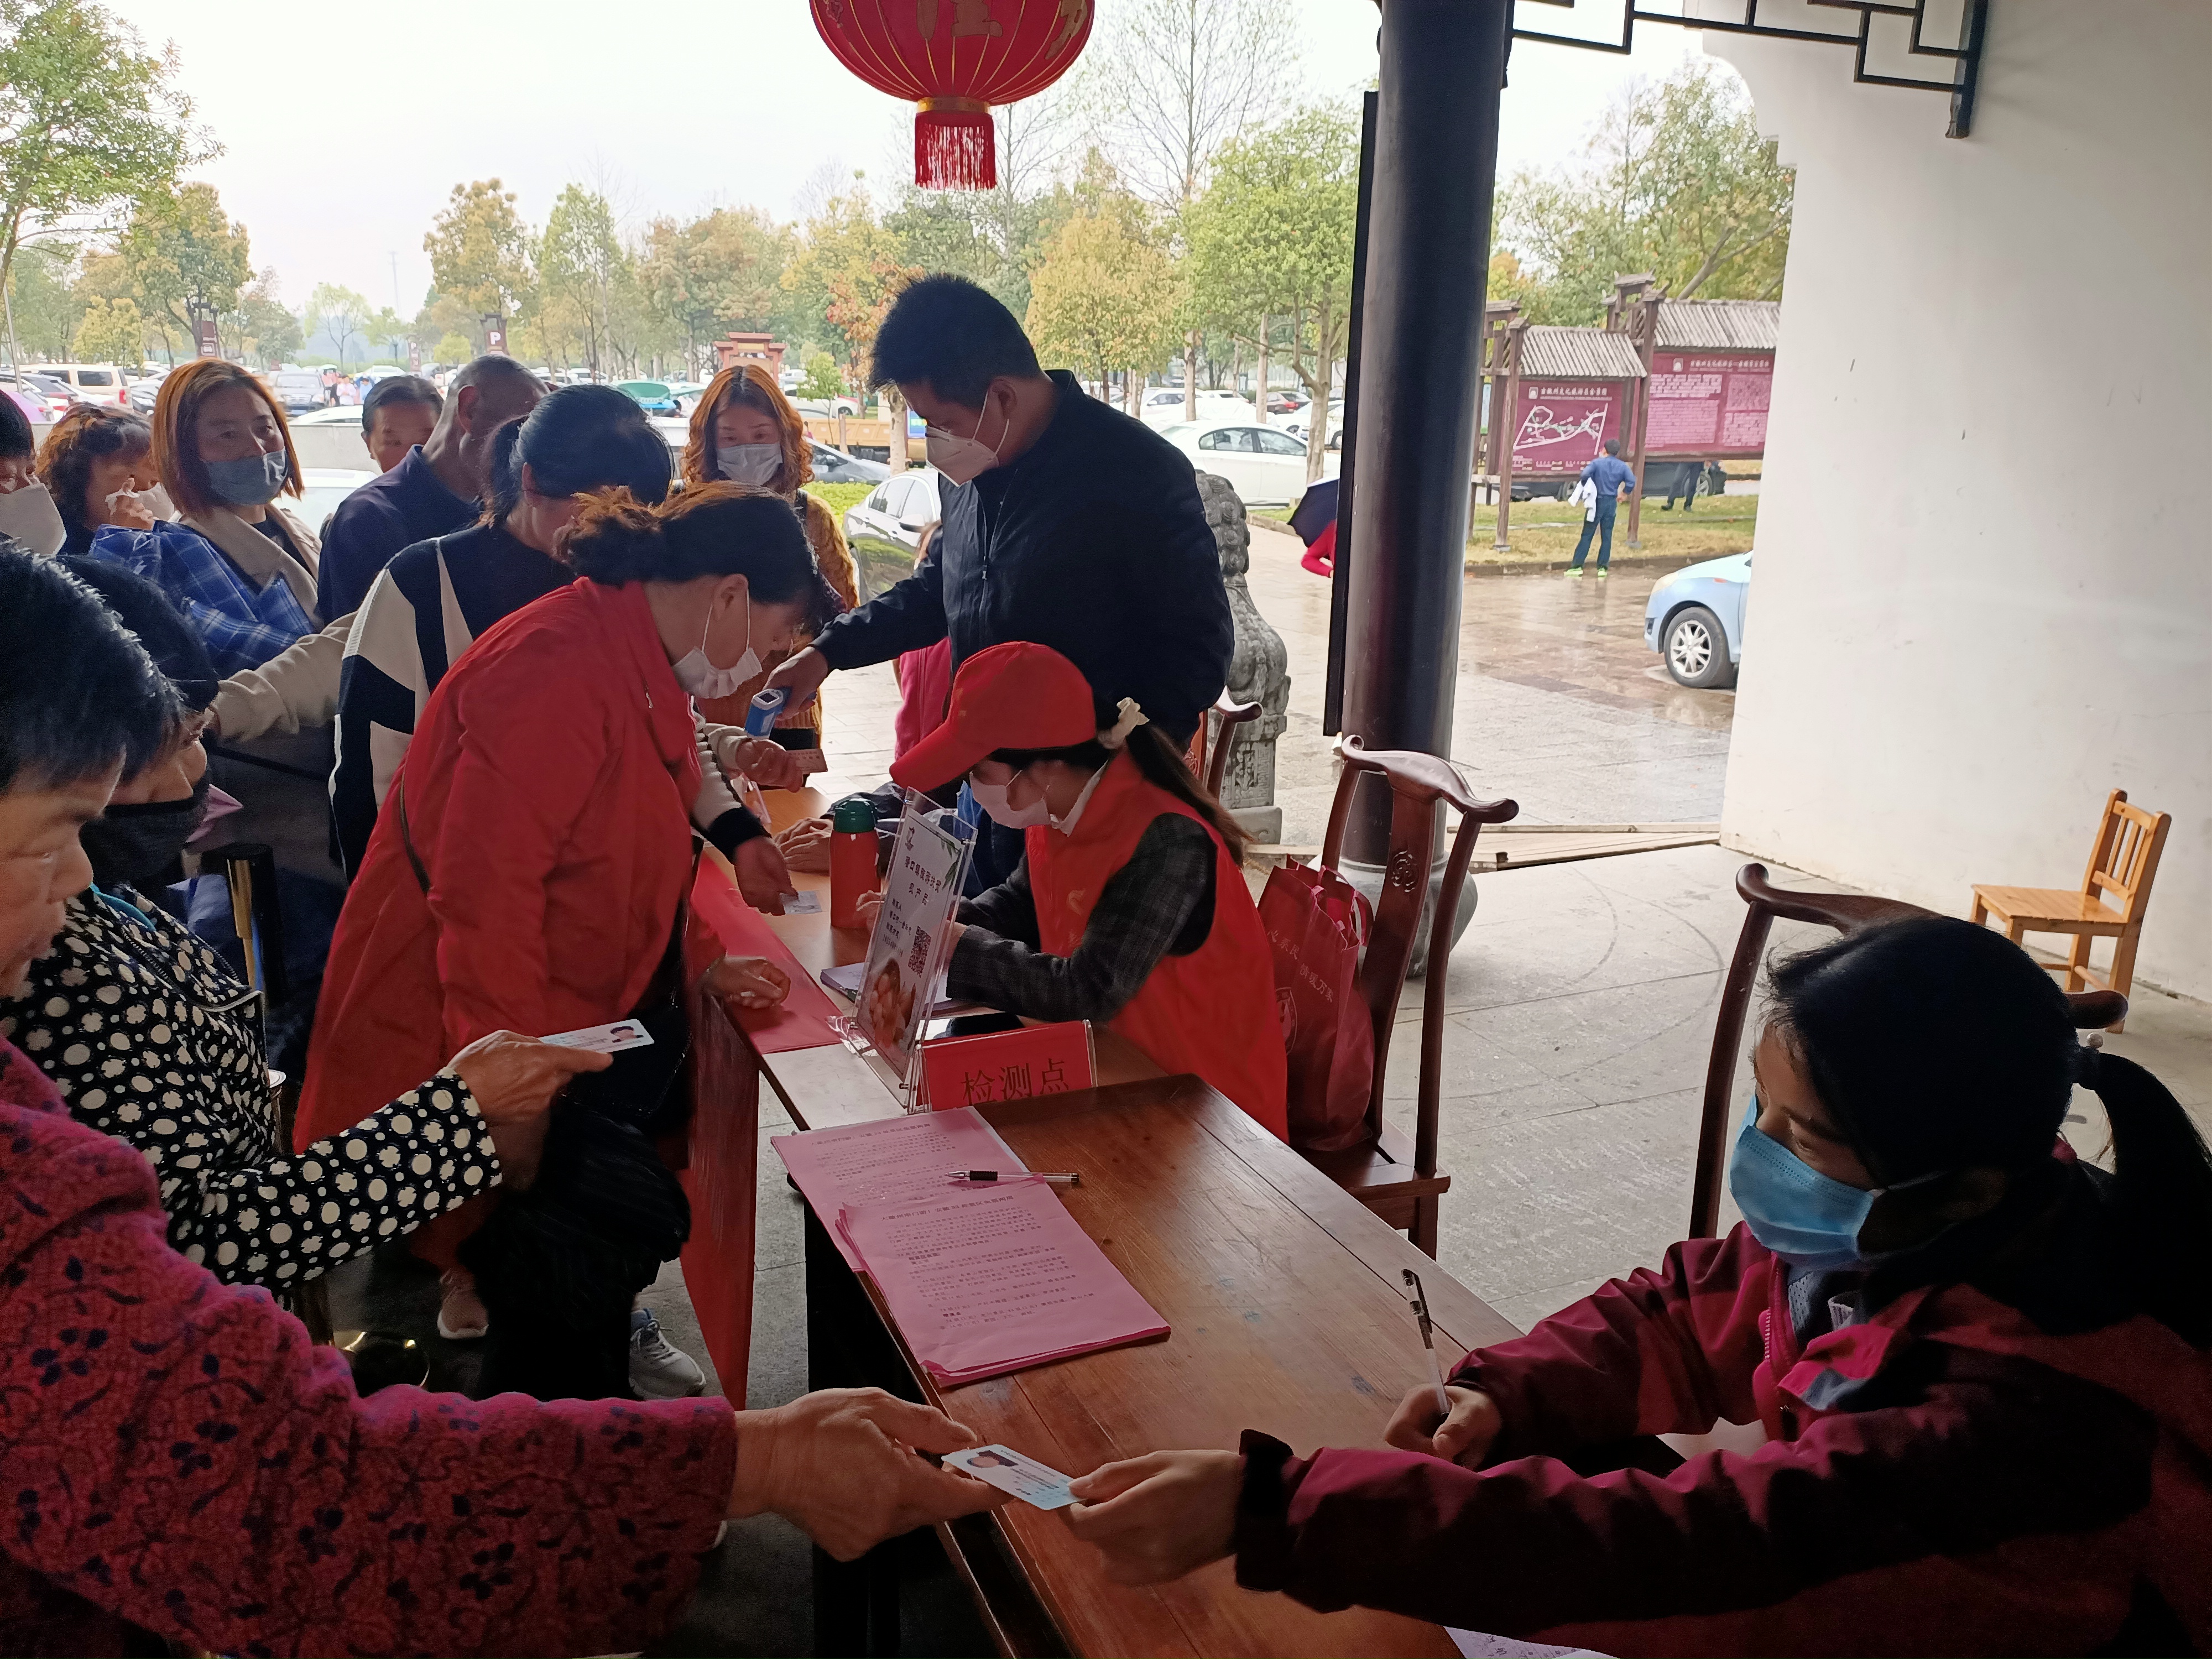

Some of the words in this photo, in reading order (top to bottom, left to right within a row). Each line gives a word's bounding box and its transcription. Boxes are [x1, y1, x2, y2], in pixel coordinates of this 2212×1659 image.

[490, 332, 501, 345] P
[961, 1058, 1069, 1106] 检测点
